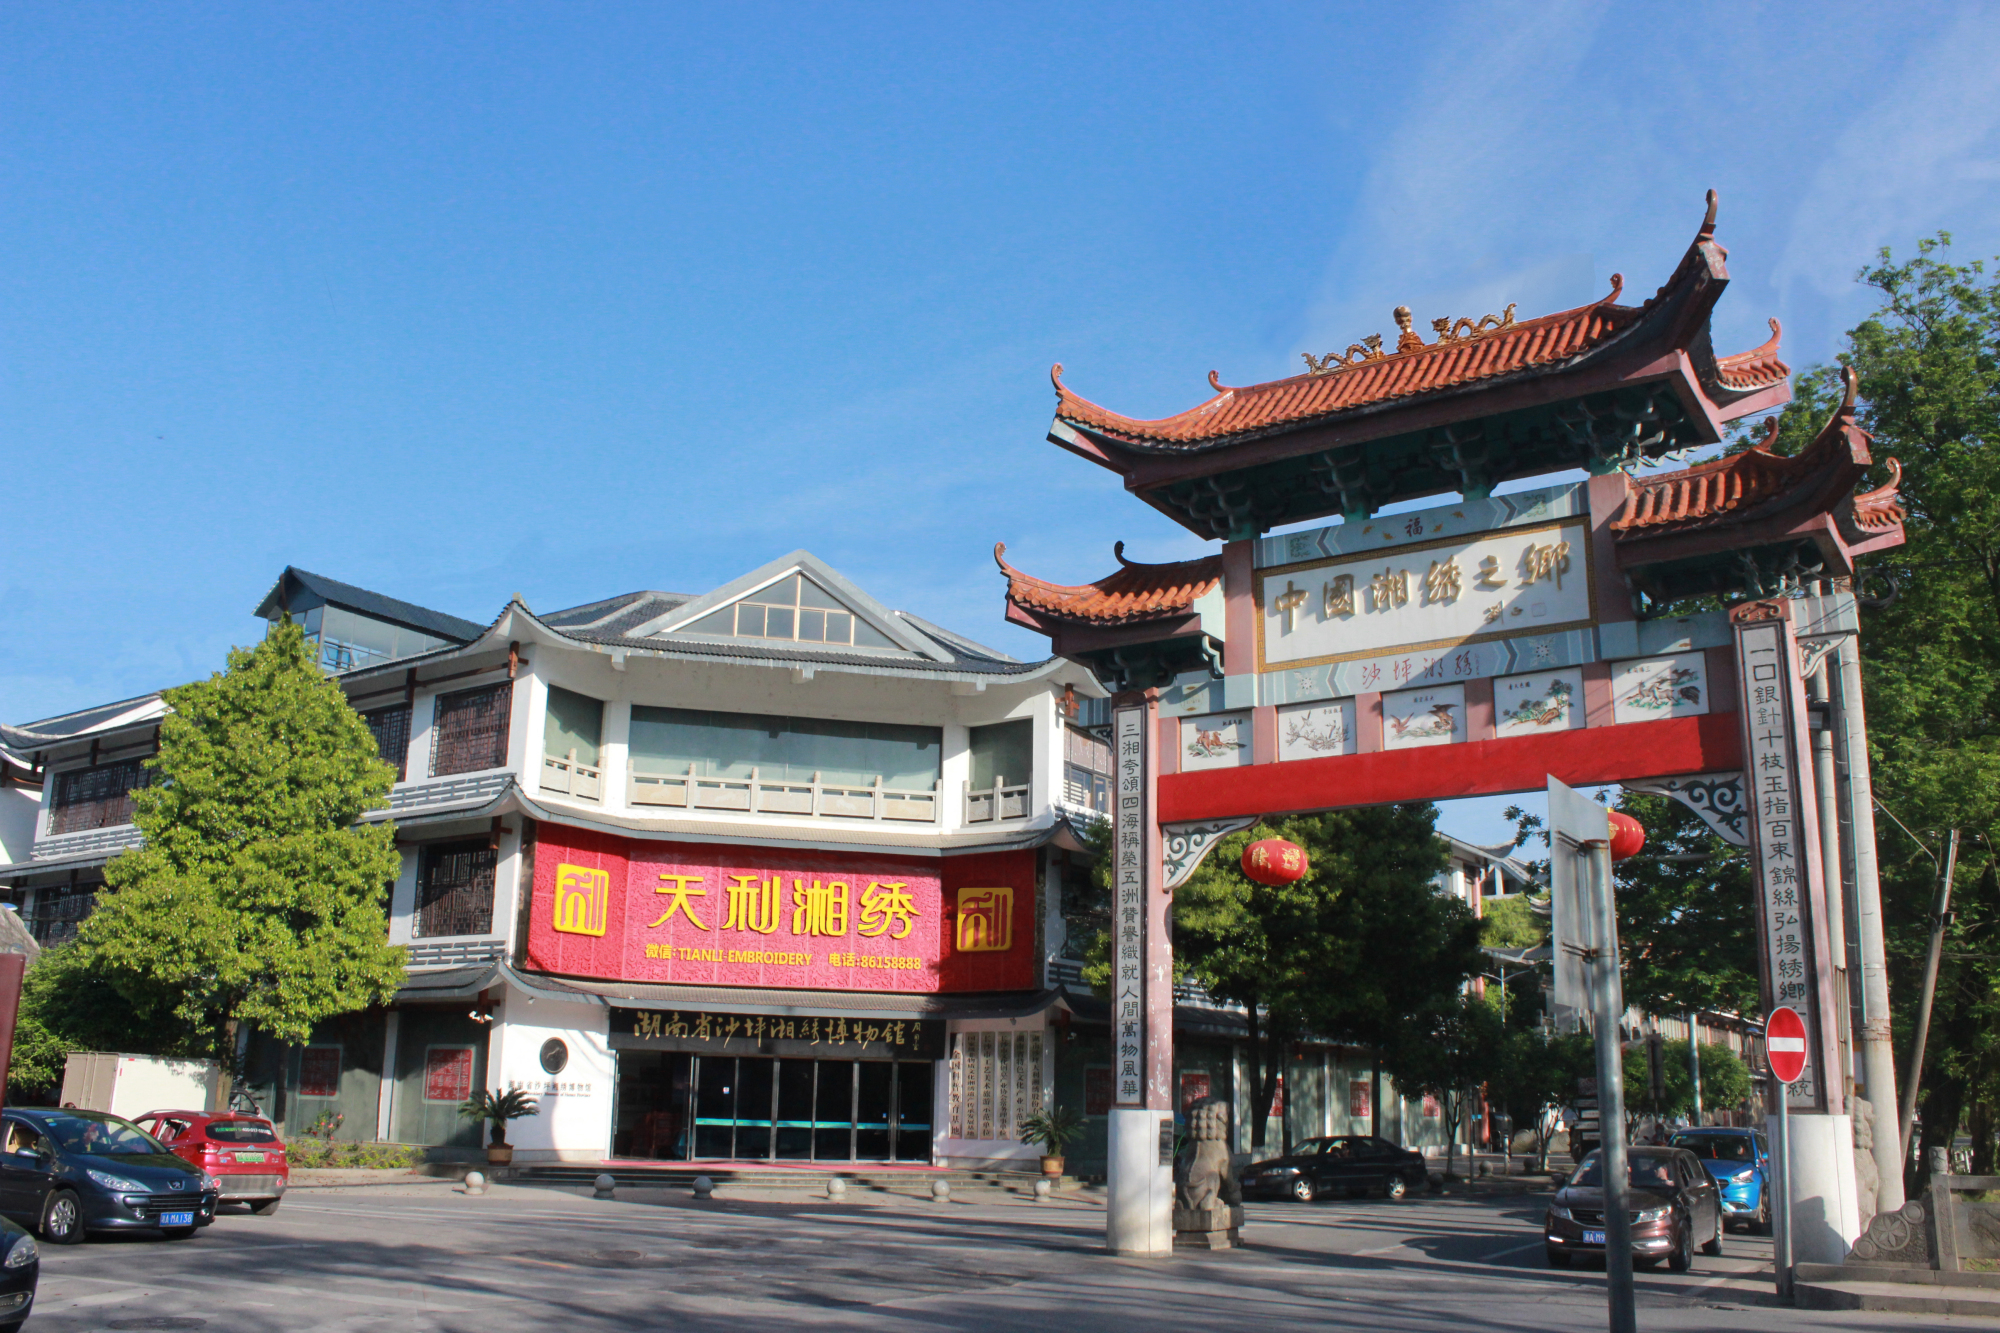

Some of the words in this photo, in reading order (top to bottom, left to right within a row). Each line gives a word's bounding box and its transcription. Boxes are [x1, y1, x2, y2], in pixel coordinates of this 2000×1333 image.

[1404, 517, 1423, 538] 福
[647, 873, 922, 940] 天利湘绣
[828, 951, 921, 970] 电话:86158888
